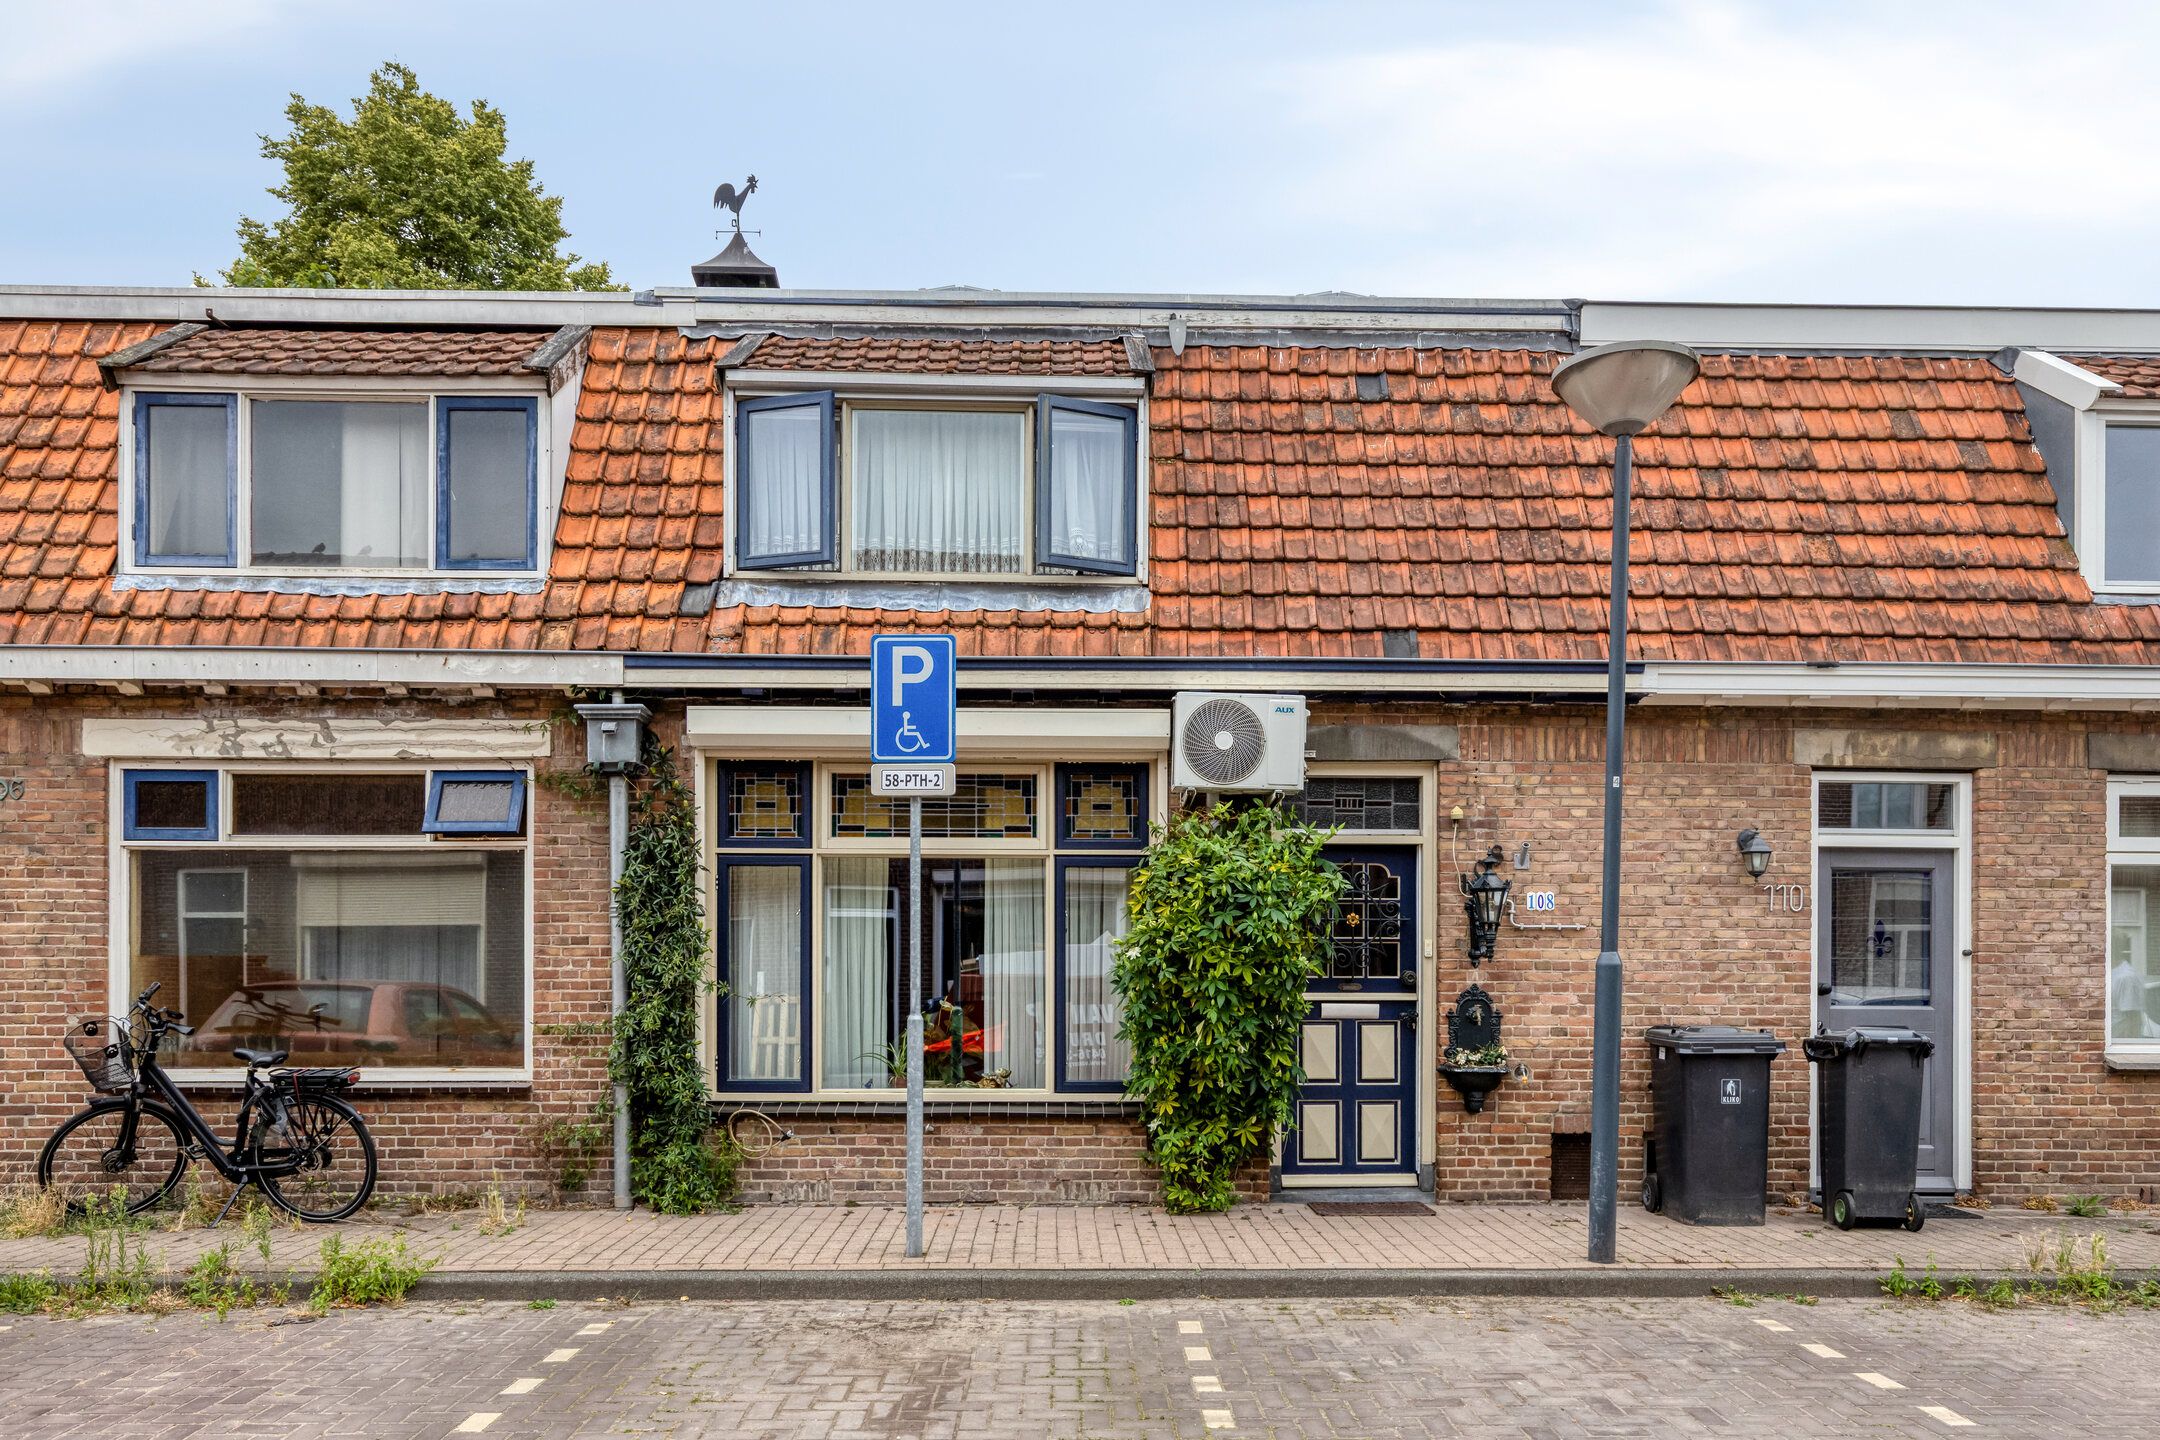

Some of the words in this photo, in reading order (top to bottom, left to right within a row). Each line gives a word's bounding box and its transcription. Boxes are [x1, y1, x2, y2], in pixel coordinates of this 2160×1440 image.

[891, 645, 934, 707] P
[1275, 706, 1295, 714] AUX
[885, 773, 941, 788] 58-PTH-2
[1528, 893, 1554, 910] 108
[1763, 884, 1804, 912] 110
